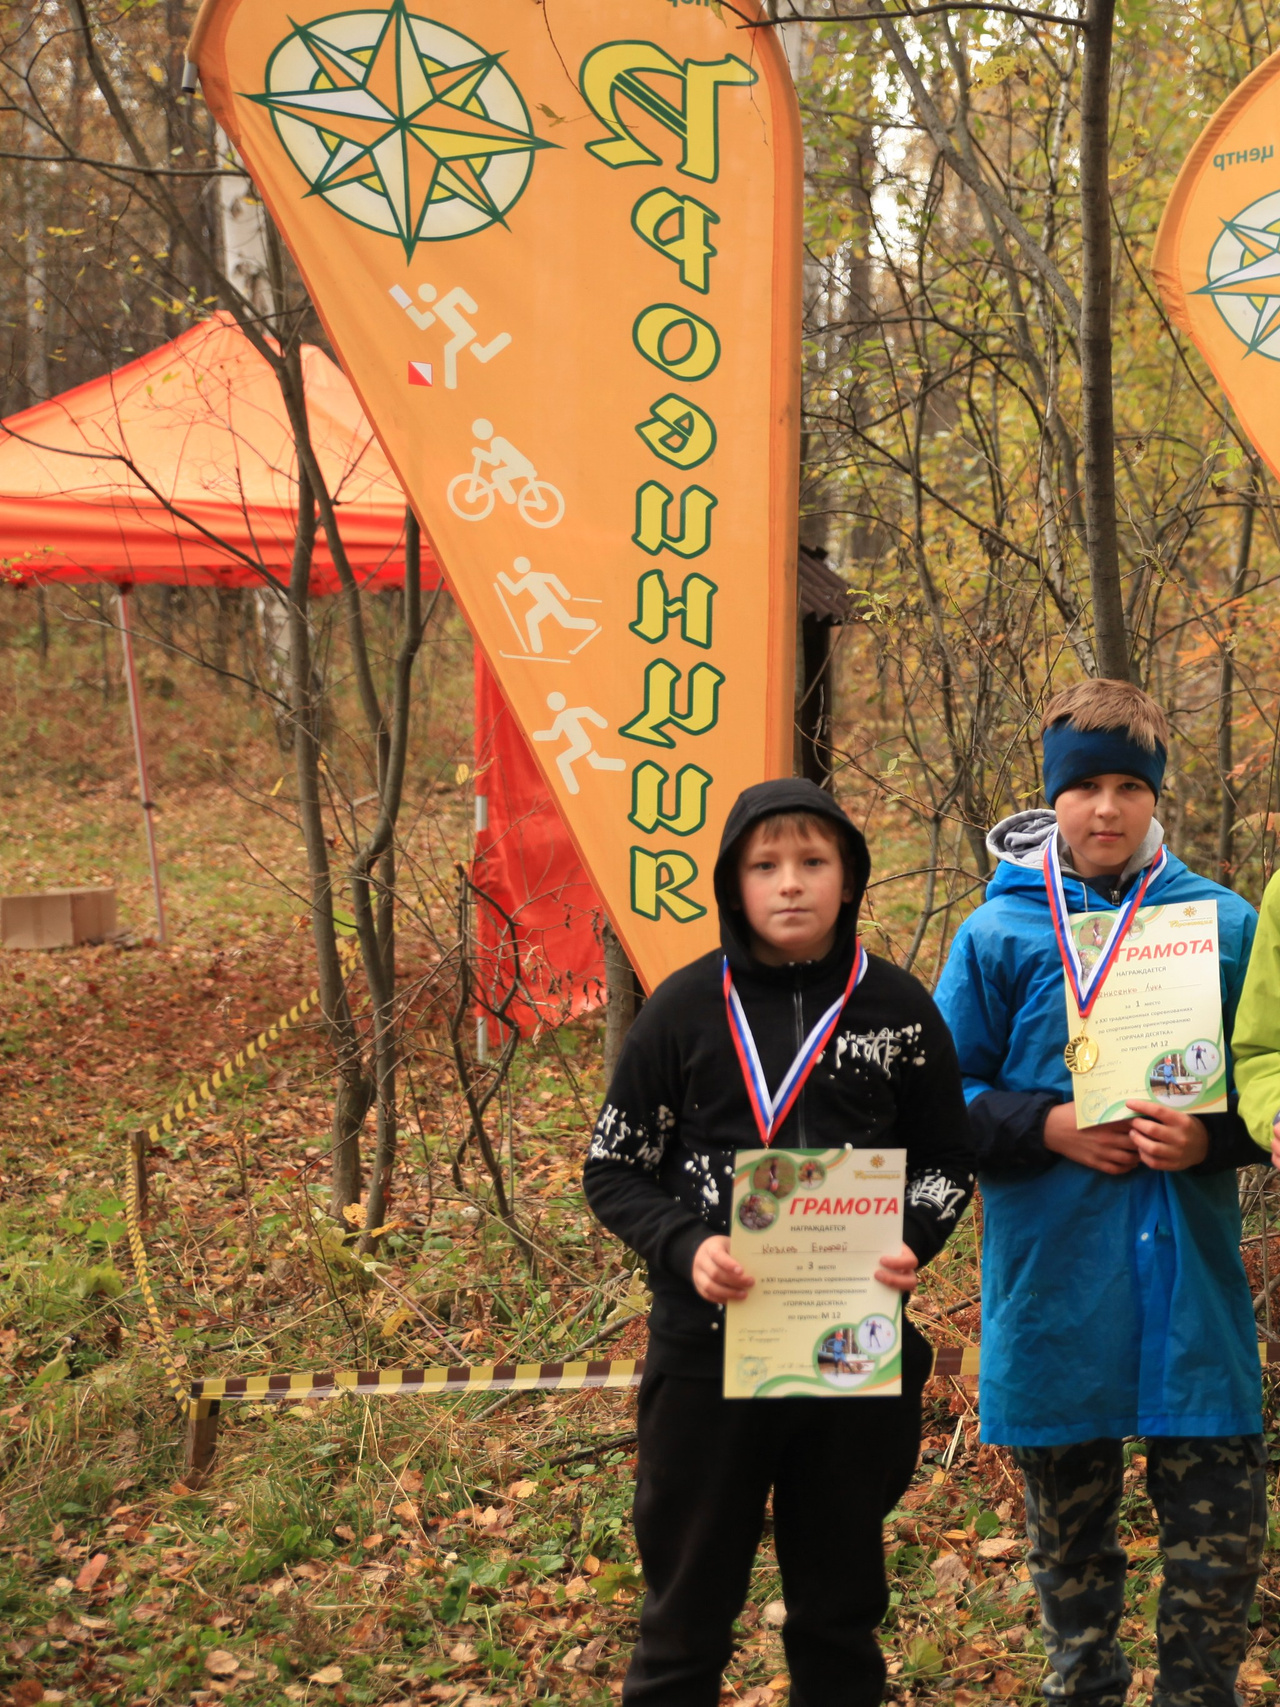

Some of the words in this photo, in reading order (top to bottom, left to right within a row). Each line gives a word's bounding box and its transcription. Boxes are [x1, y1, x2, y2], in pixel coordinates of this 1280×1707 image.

[1114, 939, 1214, 963] ГРАМОТА
[1116, 966, 1167, 977] НАГРАЖДАЕТСЯ
[1097, 988, 1138, 999] енисенко
[1136, 1000, 1140, 1008] 1
[789, 1197, 899, 1216] ГРАМОТА
[808, 1261, 814, 1270] 3
